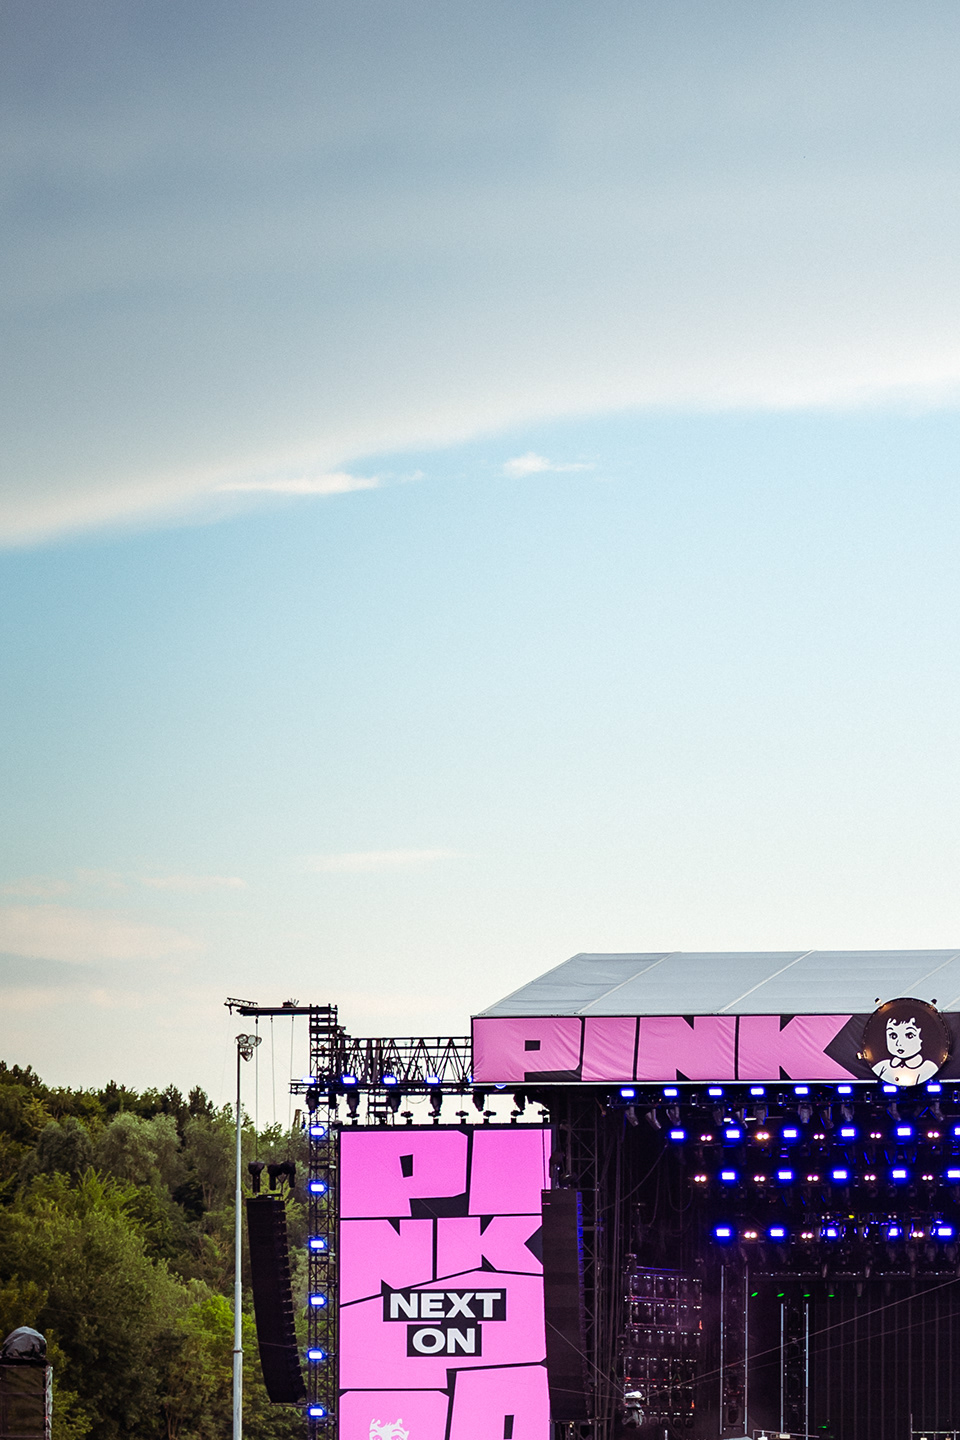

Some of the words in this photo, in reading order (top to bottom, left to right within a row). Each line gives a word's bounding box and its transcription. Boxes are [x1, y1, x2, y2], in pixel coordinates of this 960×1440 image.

[473, 1015, 860, 1082] PINK
[390, 1292, 502, 1319] NEXT
[412, 1327, 476, 1354] ON
